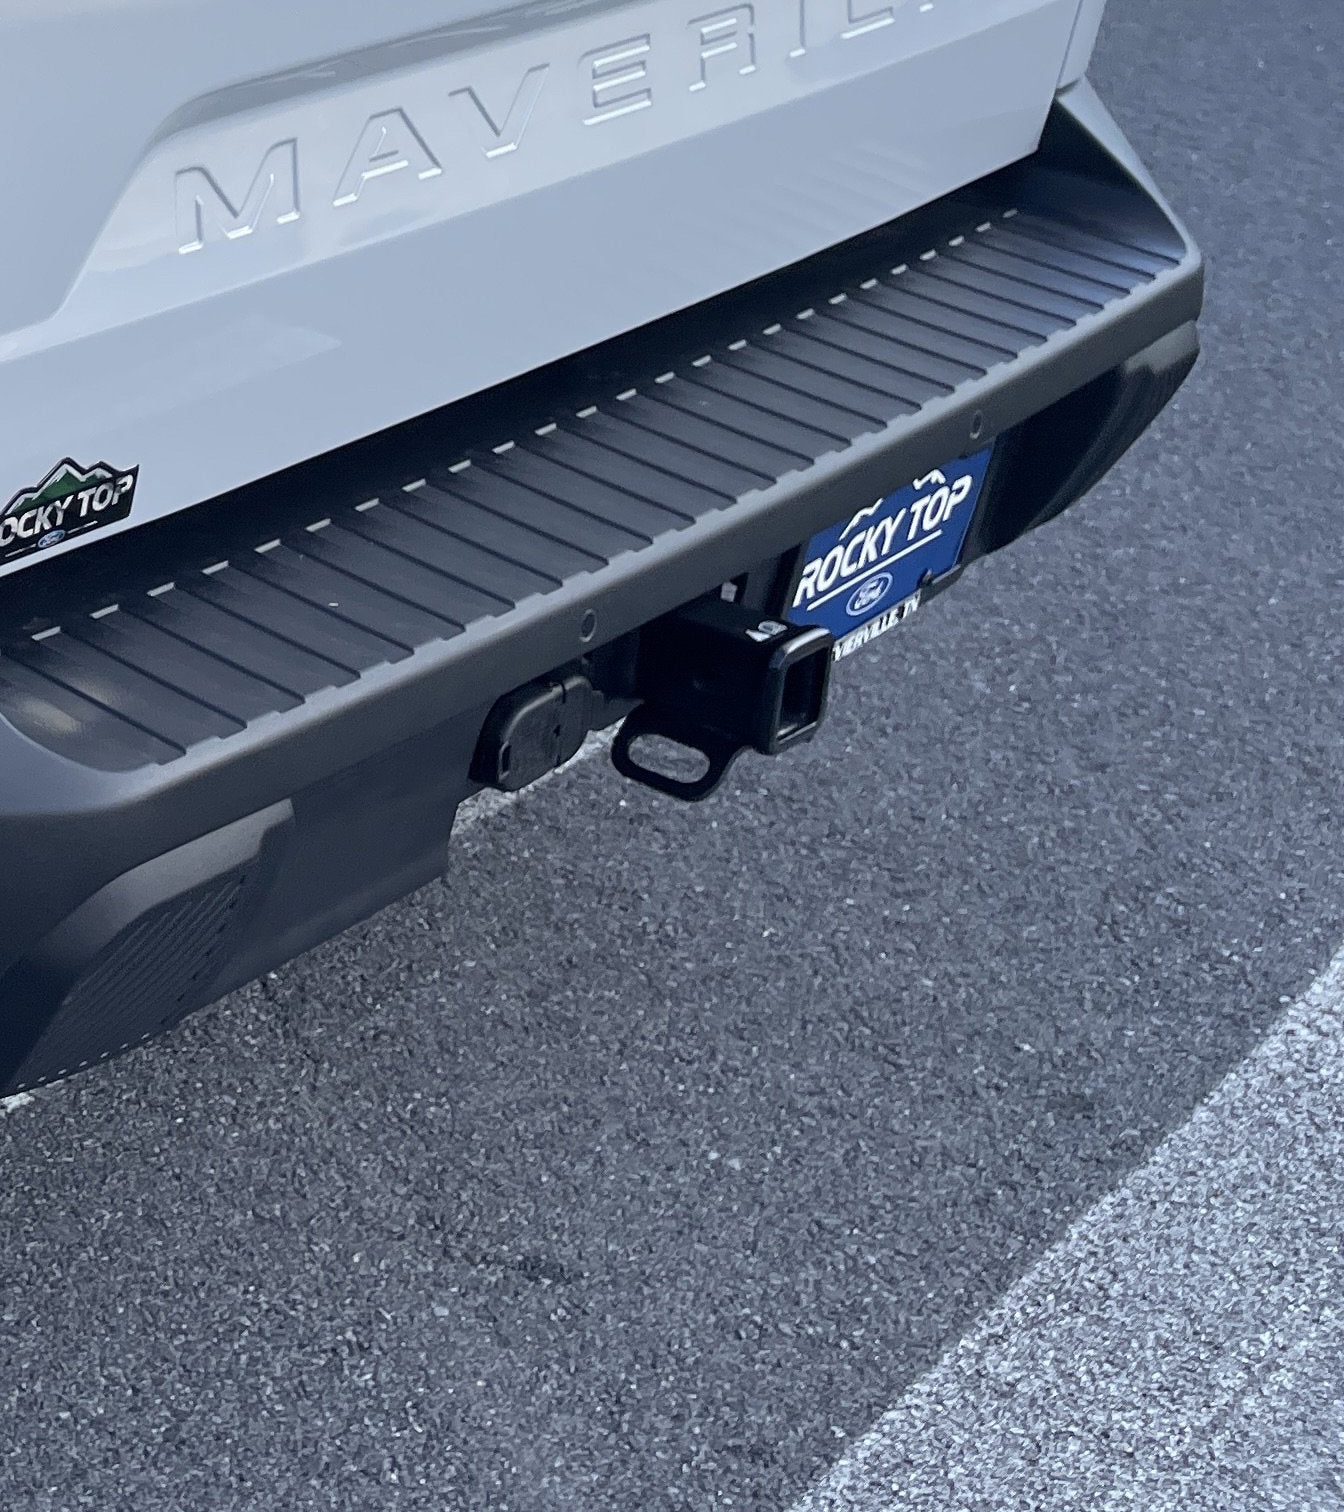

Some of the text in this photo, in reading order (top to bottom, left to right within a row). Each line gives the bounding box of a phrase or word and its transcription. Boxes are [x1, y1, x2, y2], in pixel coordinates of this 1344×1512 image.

[77, 474, 134, 518] TOP
[792, 475, 973, 608] ROCKY TOP
